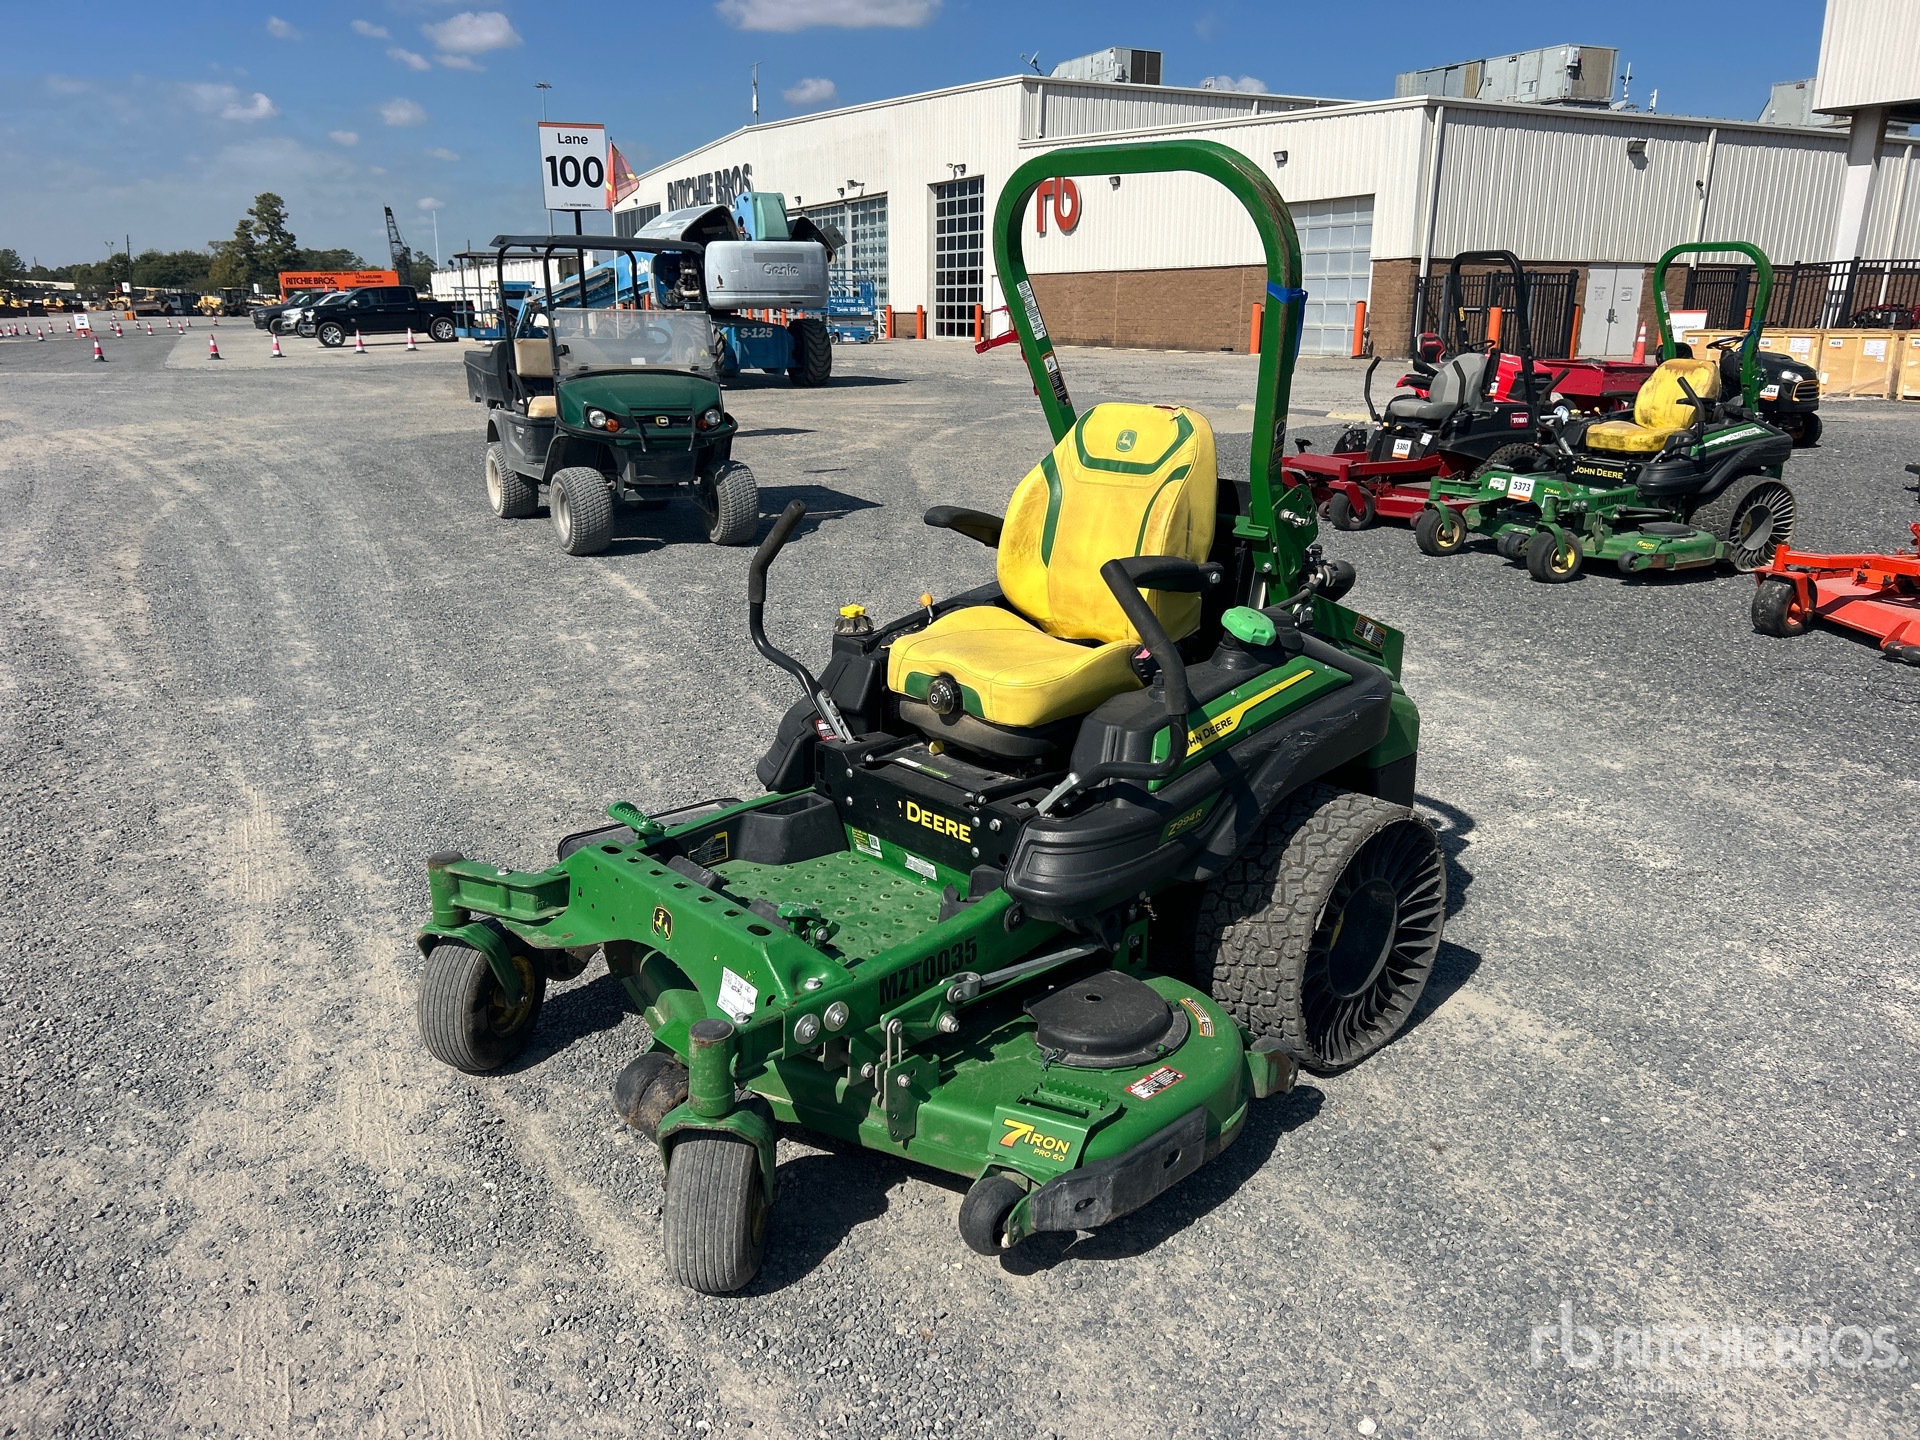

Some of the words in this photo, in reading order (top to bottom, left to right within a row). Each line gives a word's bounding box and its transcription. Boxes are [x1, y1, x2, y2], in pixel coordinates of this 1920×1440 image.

[557, 132, 589, 145] Lane
[545, 155, 605, 189] 100
[667, 173, 714, 212] RITCHIE
[762, 263, 799, 276] Genie
[285, 277, 313, 285] RITCHIE
[314, 277, 337, 285] BROS.
[740, 327, 773, 339] S-125
[1396, 442, 1409, 451] 5380
[1574, 465, 1595, 475] JOHN
[1596, 468, 1624, 480] DEERE
[1513, 481, 1531, 492] 5373
[1187, 734, 1203, 749] HN
[1203, 716, 1233, 740] DEERE
[906, 800, 971, 843] DEERE
[1168, 809, 1202, 836] Z994R
[879, 935, 977, 1006] MZT0035
[1033, 1148, 1051, 1158] PRO
[1052, 1153, 1065, 1162] 60
